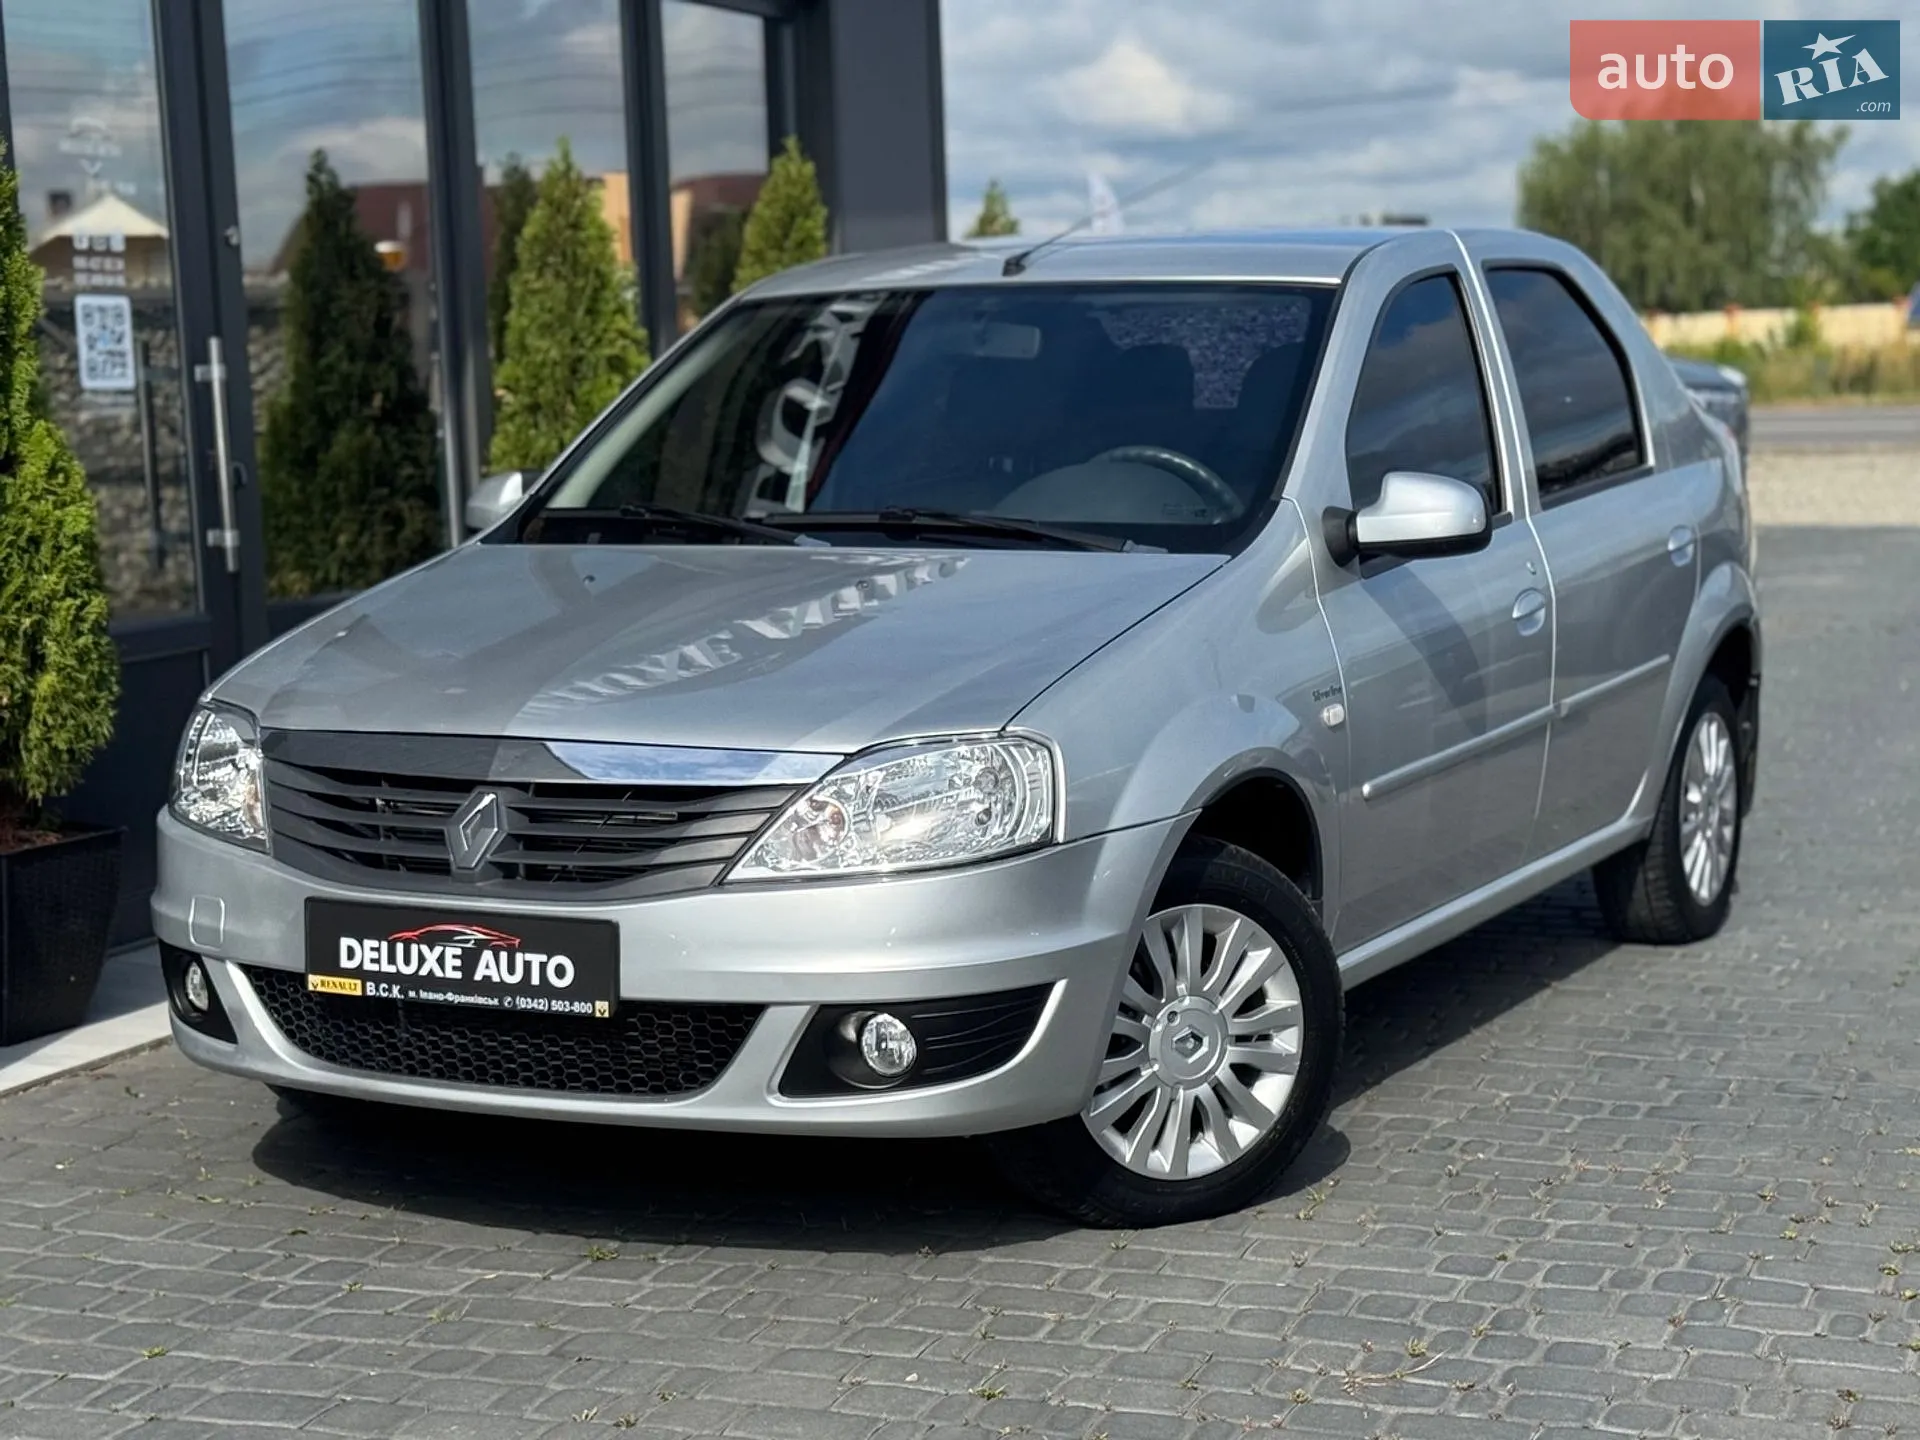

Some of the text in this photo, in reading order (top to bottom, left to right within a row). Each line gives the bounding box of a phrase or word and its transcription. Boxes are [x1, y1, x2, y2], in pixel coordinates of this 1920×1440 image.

[339, 936, 575, 988] DELUXE AUTO
[319, 979, 361, 993] RENAULT
[516, 996, 549, 1012] (0342)
[551, 999, 593, 1014] 503-800
